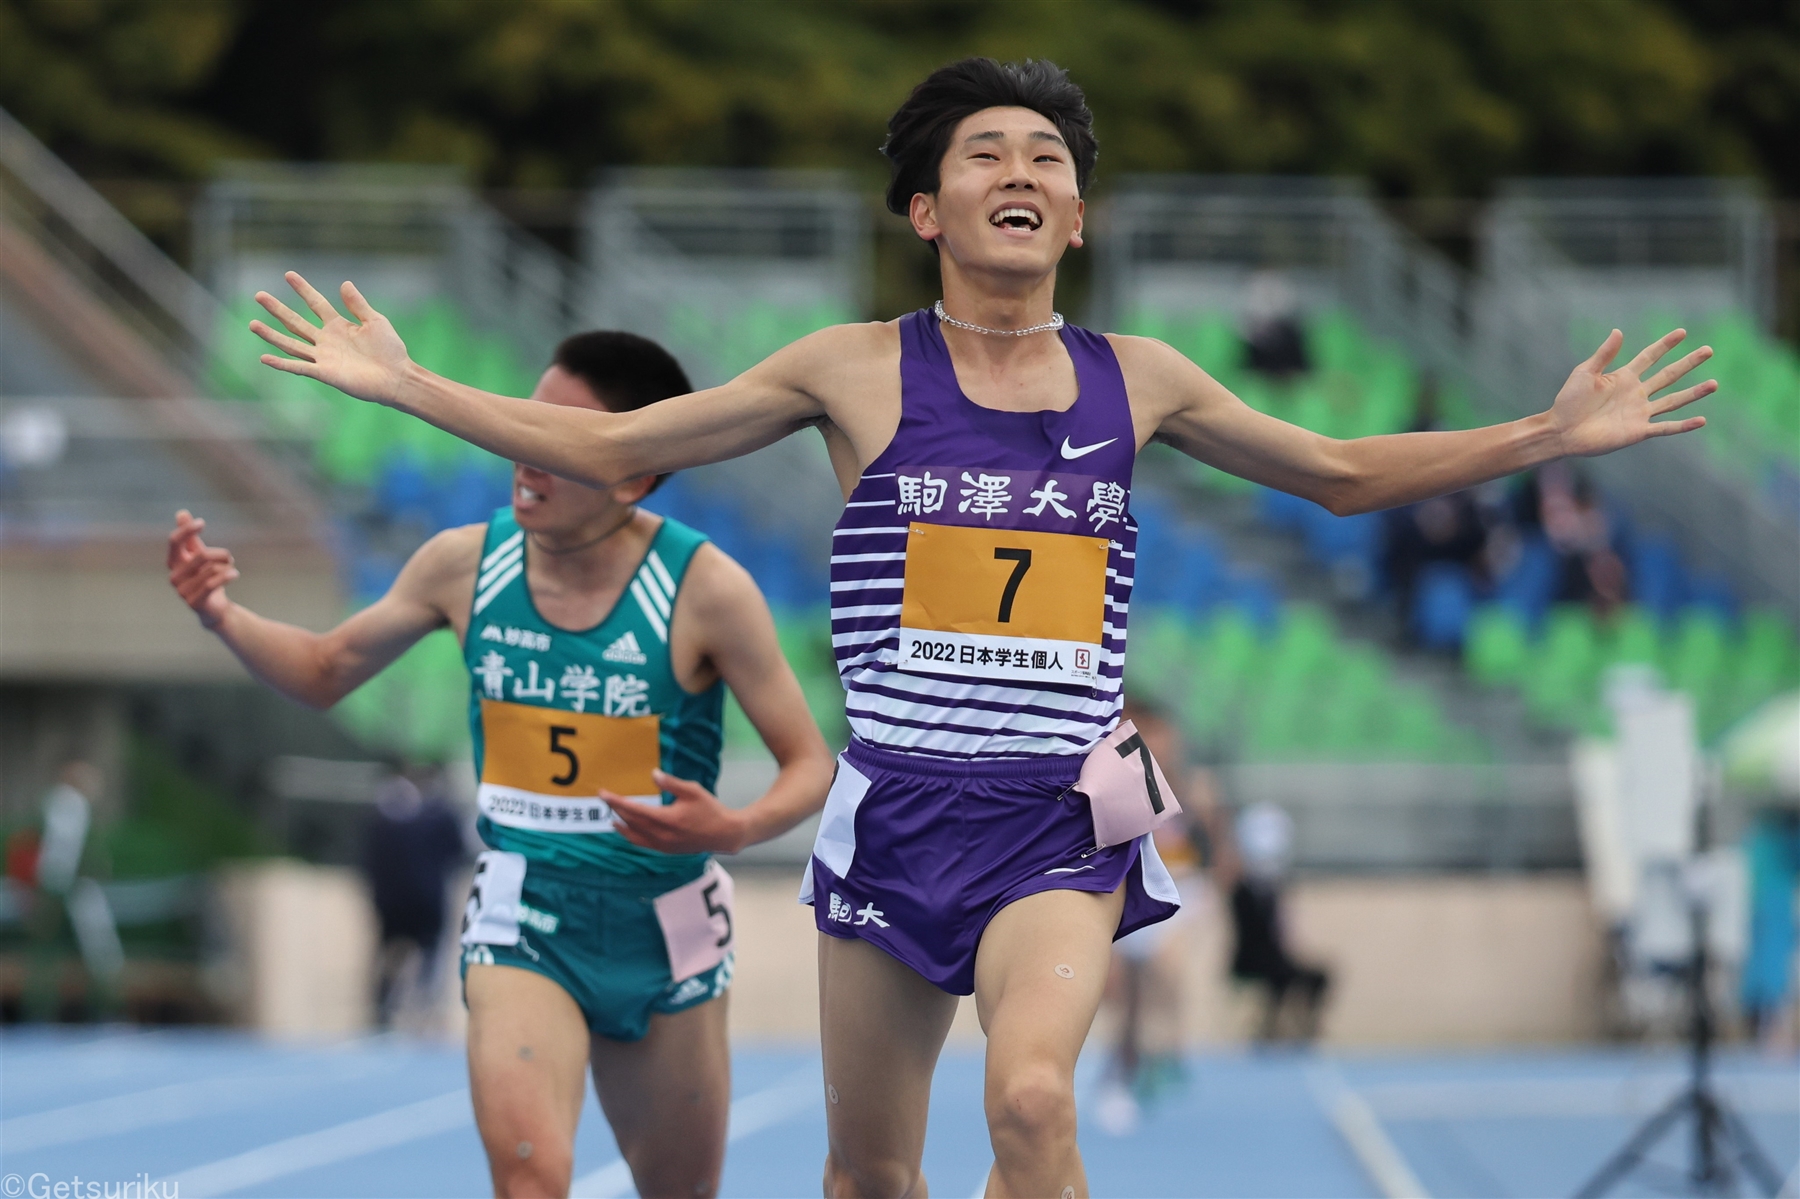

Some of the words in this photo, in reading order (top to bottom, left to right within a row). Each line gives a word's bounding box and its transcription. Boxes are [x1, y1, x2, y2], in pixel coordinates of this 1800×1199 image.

[897, 471, 1126, 533] 駒澤大學
[993, 547, 1033, 624] 7
[472, 649, 652, 718] 青山学院
[549, 725, 580, 787] 5
[1113, 731, 1166, 816] 7
[699, 879, 733, 948] 5
[827, 891, 891, 928] 駒大
